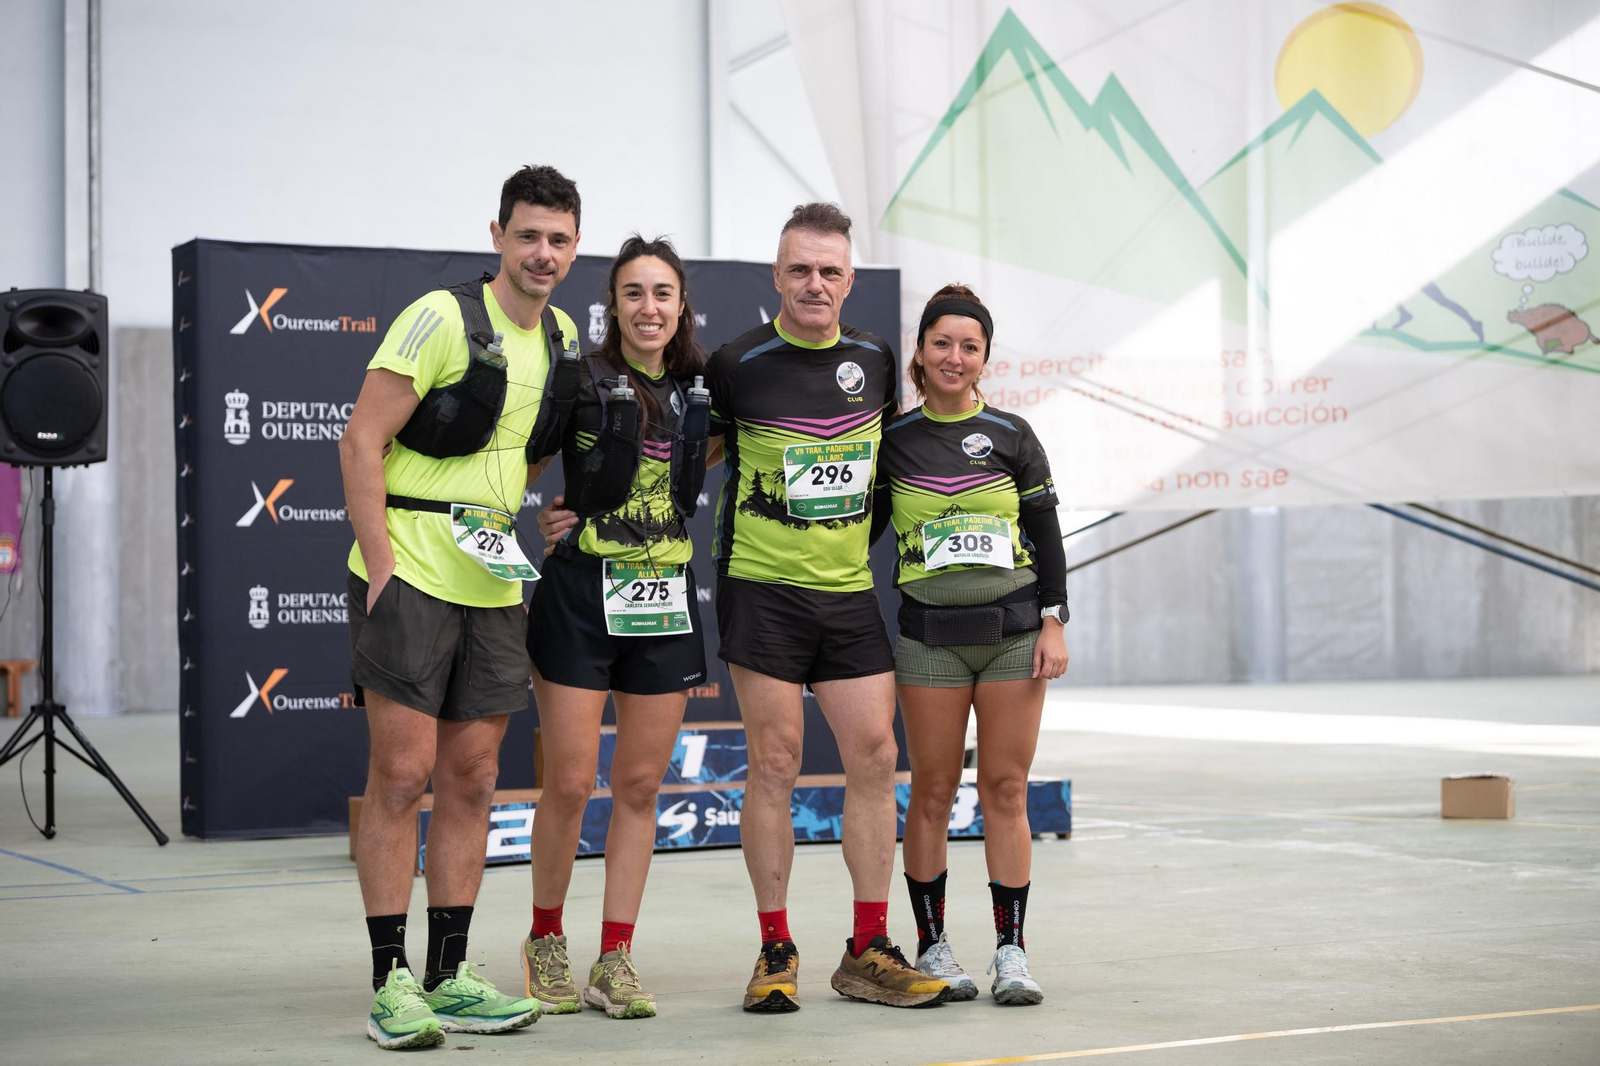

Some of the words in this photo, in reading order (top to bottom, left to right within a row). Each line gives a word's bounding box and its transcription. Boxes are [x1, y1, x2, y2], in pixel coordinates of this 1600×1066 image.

[273, 313, 377, 333] OurenseTrail
[261, 421, 347, 441] OURENS
[817, 453, 844, 463] ALLARIZ
[826, 444, 855, 454] PADERNE
[856, 443, 864, 451] DE
[811, 463, 853, 486] 296
[1175, 470, 1230, 490] non
[1240, 467, 1290, 489] sae
[279, 504, 351, 522] Ourense
[963, 516, 993, 526] PADERNE
[954, 524, 984, 533] ALLARIZ
[477, 529, 505, 555] 276
[948, 533, 994, 553] 308
[626, 562, 646, 570] TRAIL
[631, 580, 669, 602] 275
[680, 734, 709, 778] 1
[485, 808, 535, 858] 2
